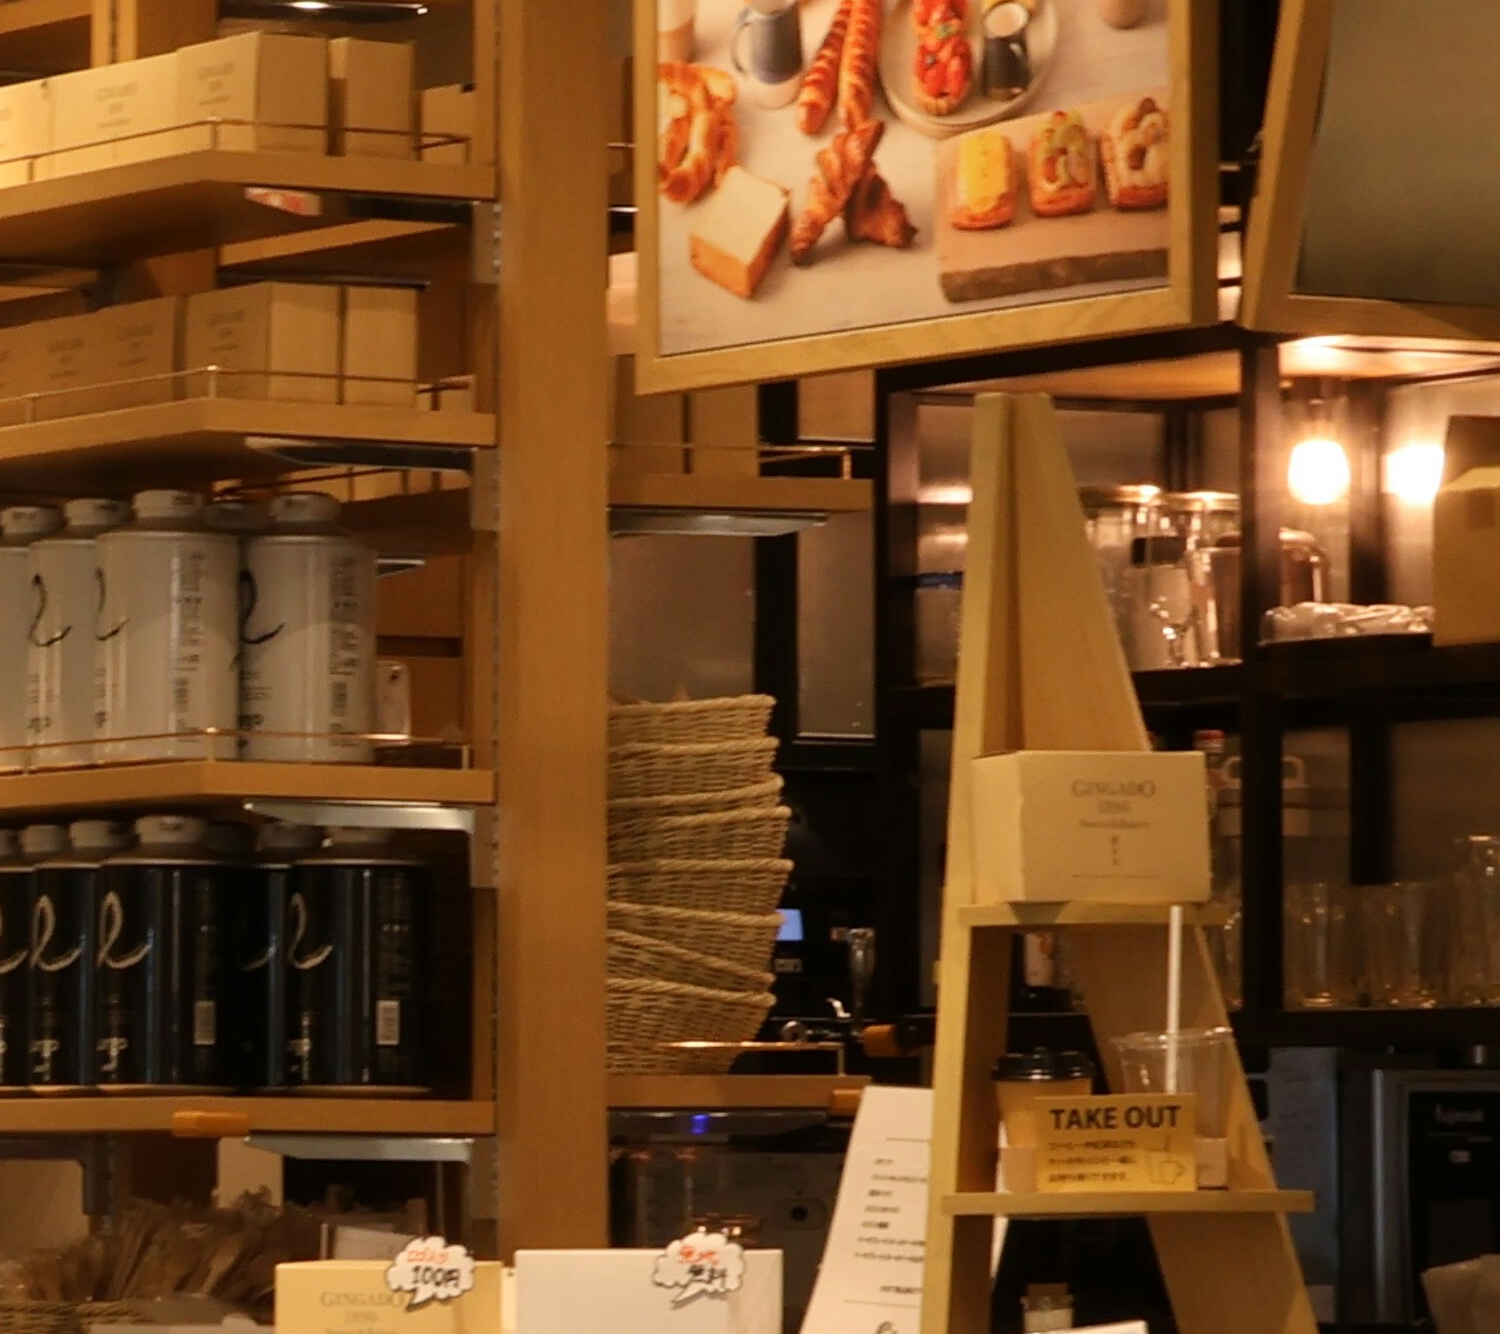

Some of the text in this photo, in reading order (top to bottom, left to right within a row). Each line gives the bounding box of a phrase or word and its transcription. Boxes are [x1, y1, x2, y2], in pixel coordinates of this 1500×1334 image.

[1048, 1104, 1183, 1131] TAKE OUT
[412, 1265, 461, 1288] 100円
